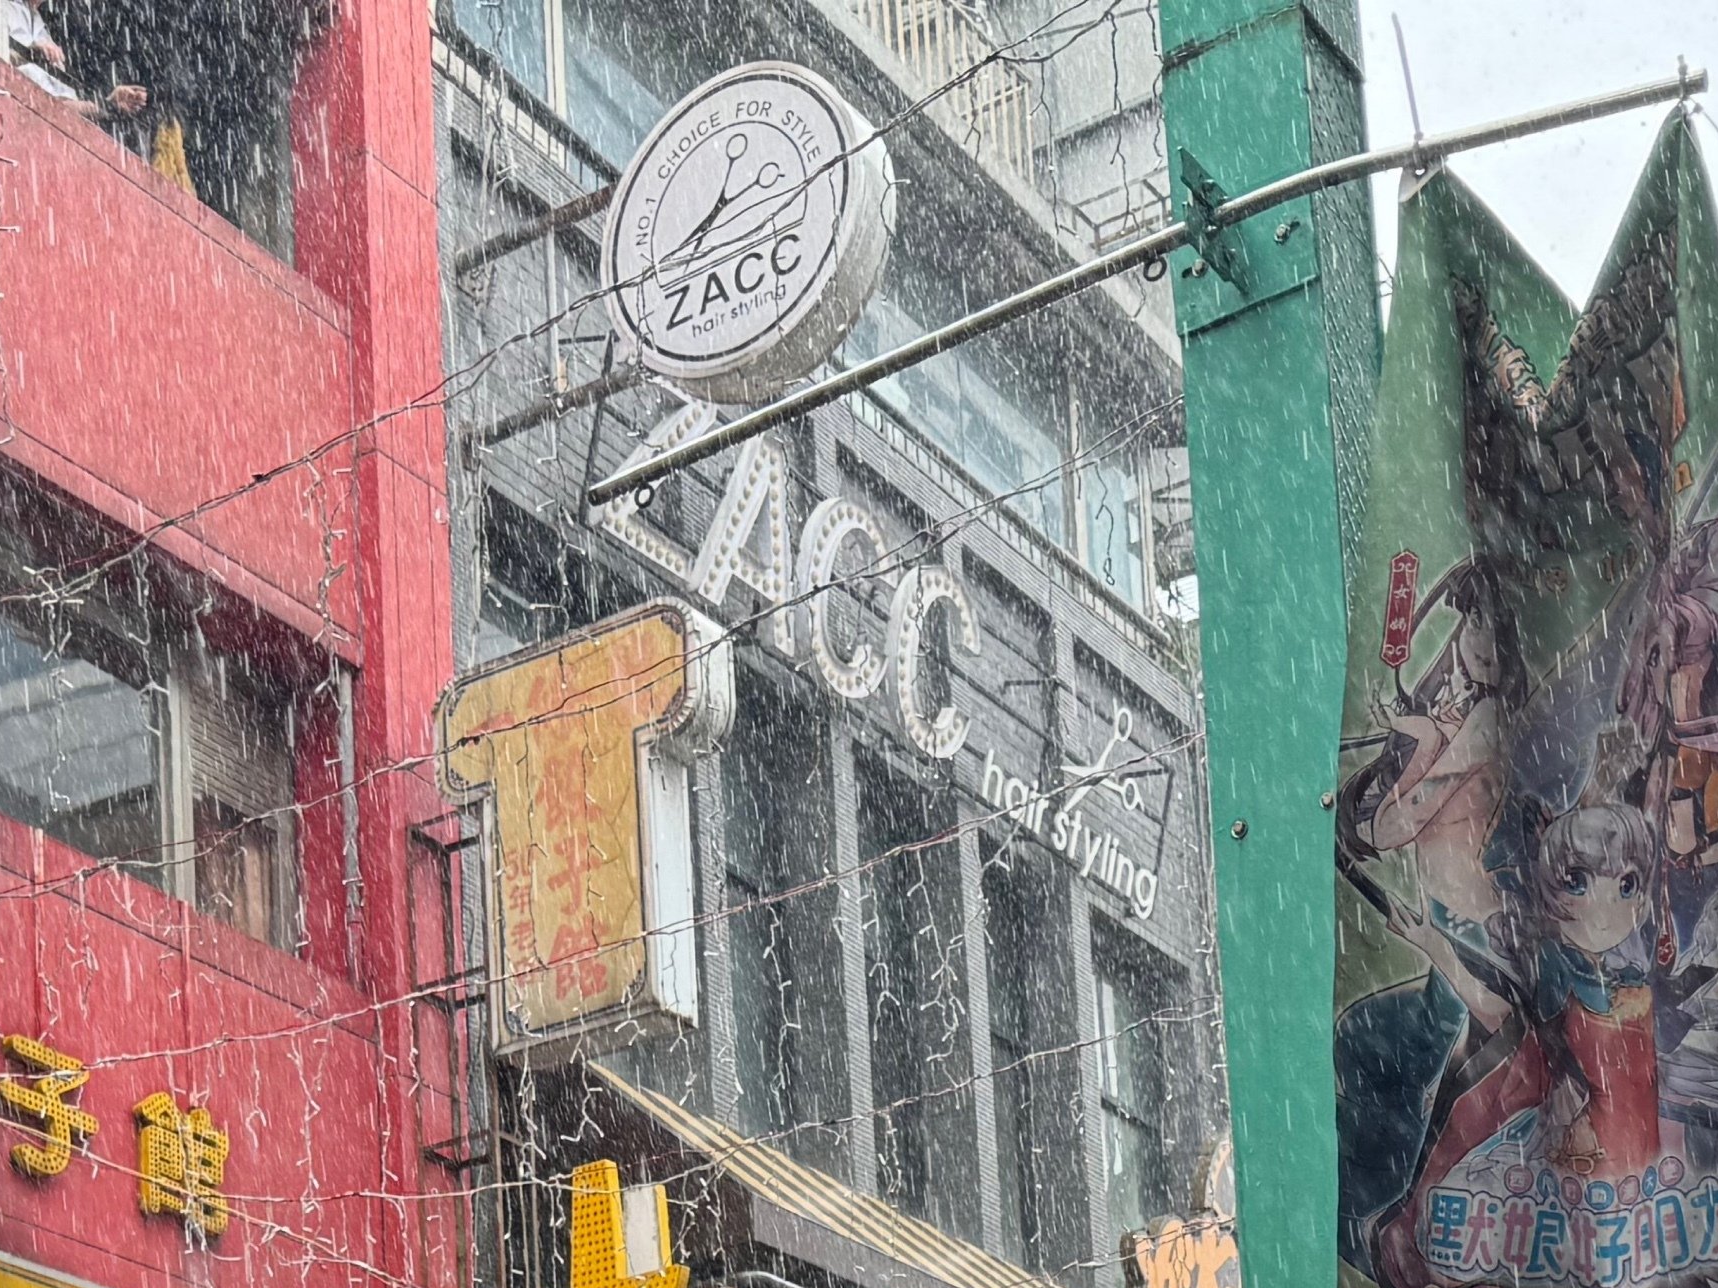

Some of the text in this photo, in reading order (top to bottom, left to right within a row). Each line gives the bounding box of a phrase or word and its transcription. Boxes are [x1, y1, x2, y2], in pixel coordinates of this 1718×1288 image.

[658, 111, 722, 180] CHOICE
[735, 100, 772, 119] FOR
[781, 109, 821, 163] STYLE
[665, 234, 802, 332] ZACC
[692, 284, 787, 338] hair styling
[982, 750, 1158, 918] hair styling
